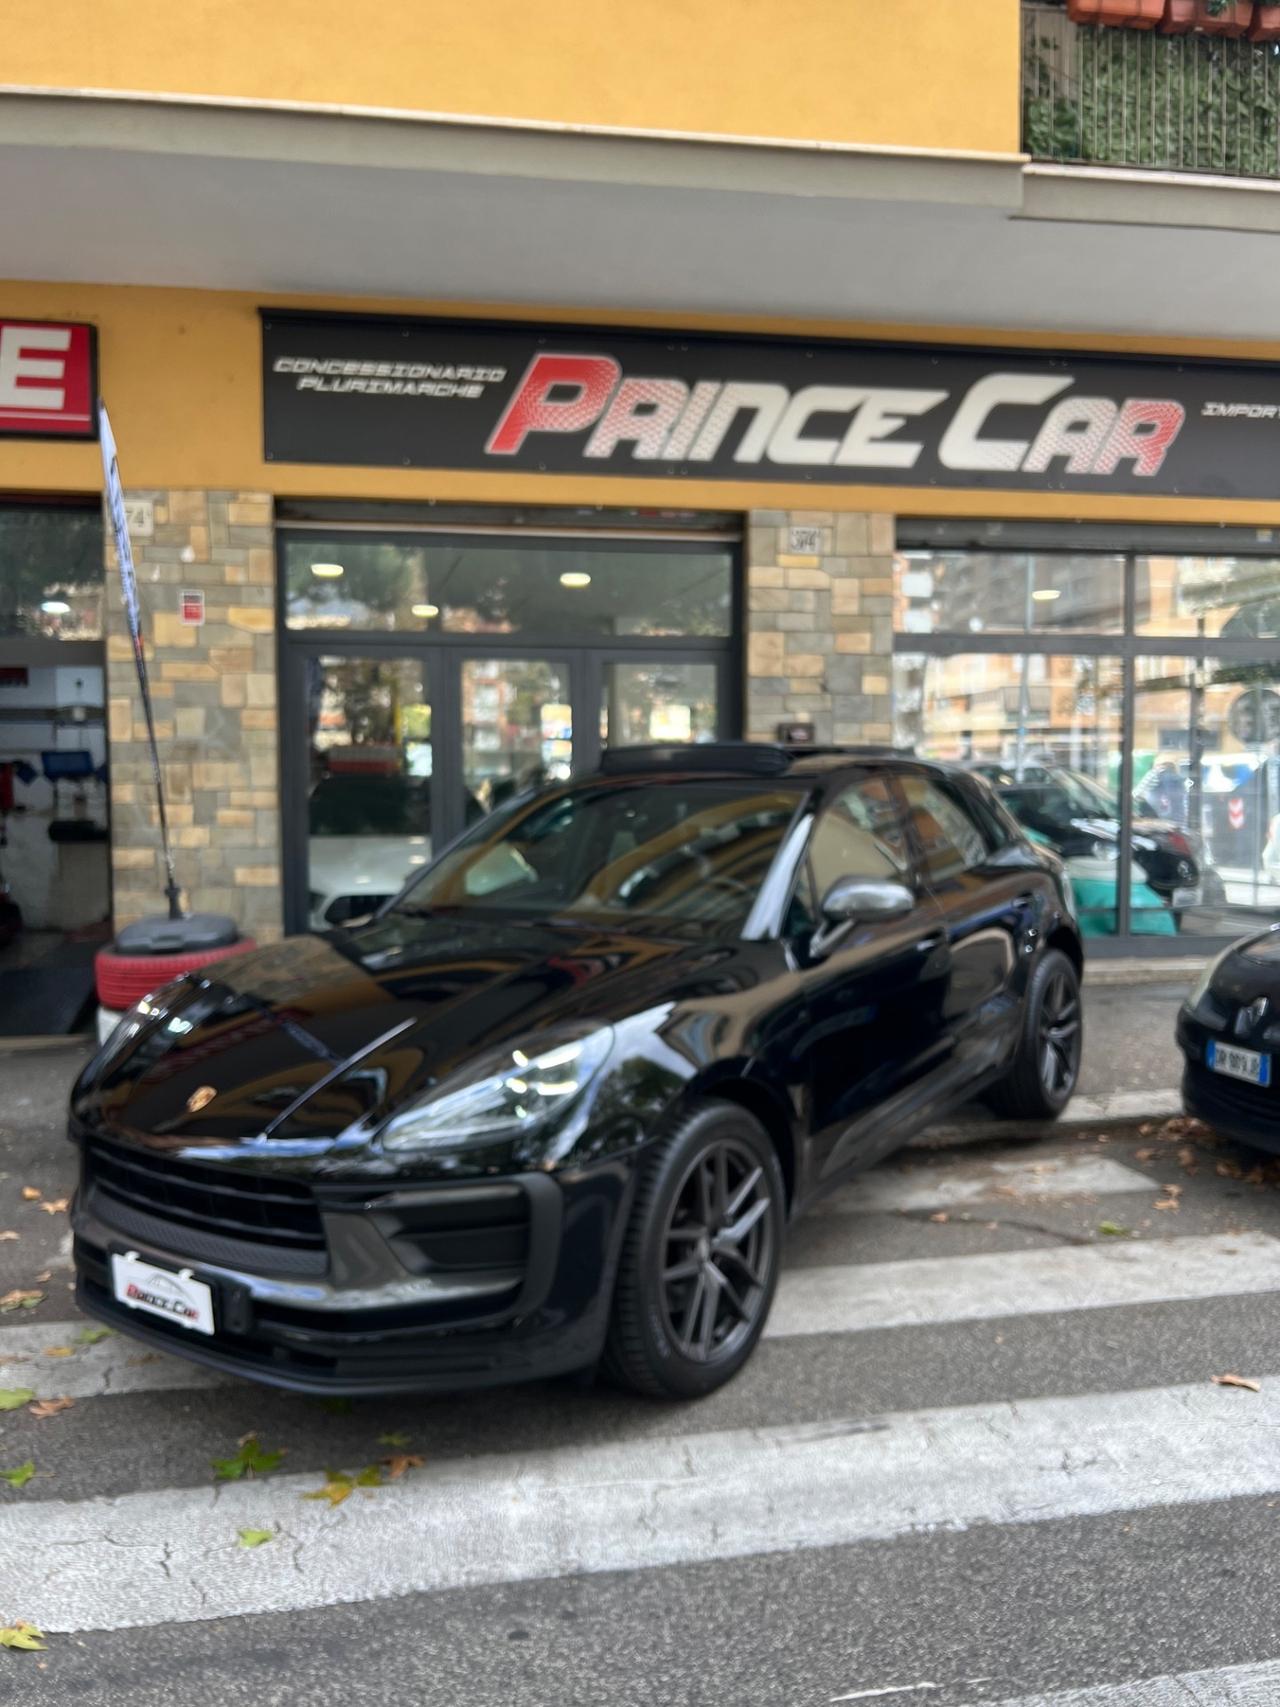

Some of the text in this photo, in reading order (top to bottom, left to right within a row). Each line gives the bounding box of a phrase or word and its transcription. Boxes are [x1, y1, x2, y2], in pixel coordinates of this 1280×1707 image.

[273, 356, 507, 382] CONCESSIONARIO
[296, 375, 485, 398] PLURIMARCHE
[1201, 402, 1280, 419] IMPOR
[938, 373, 1186, 477] CAR
